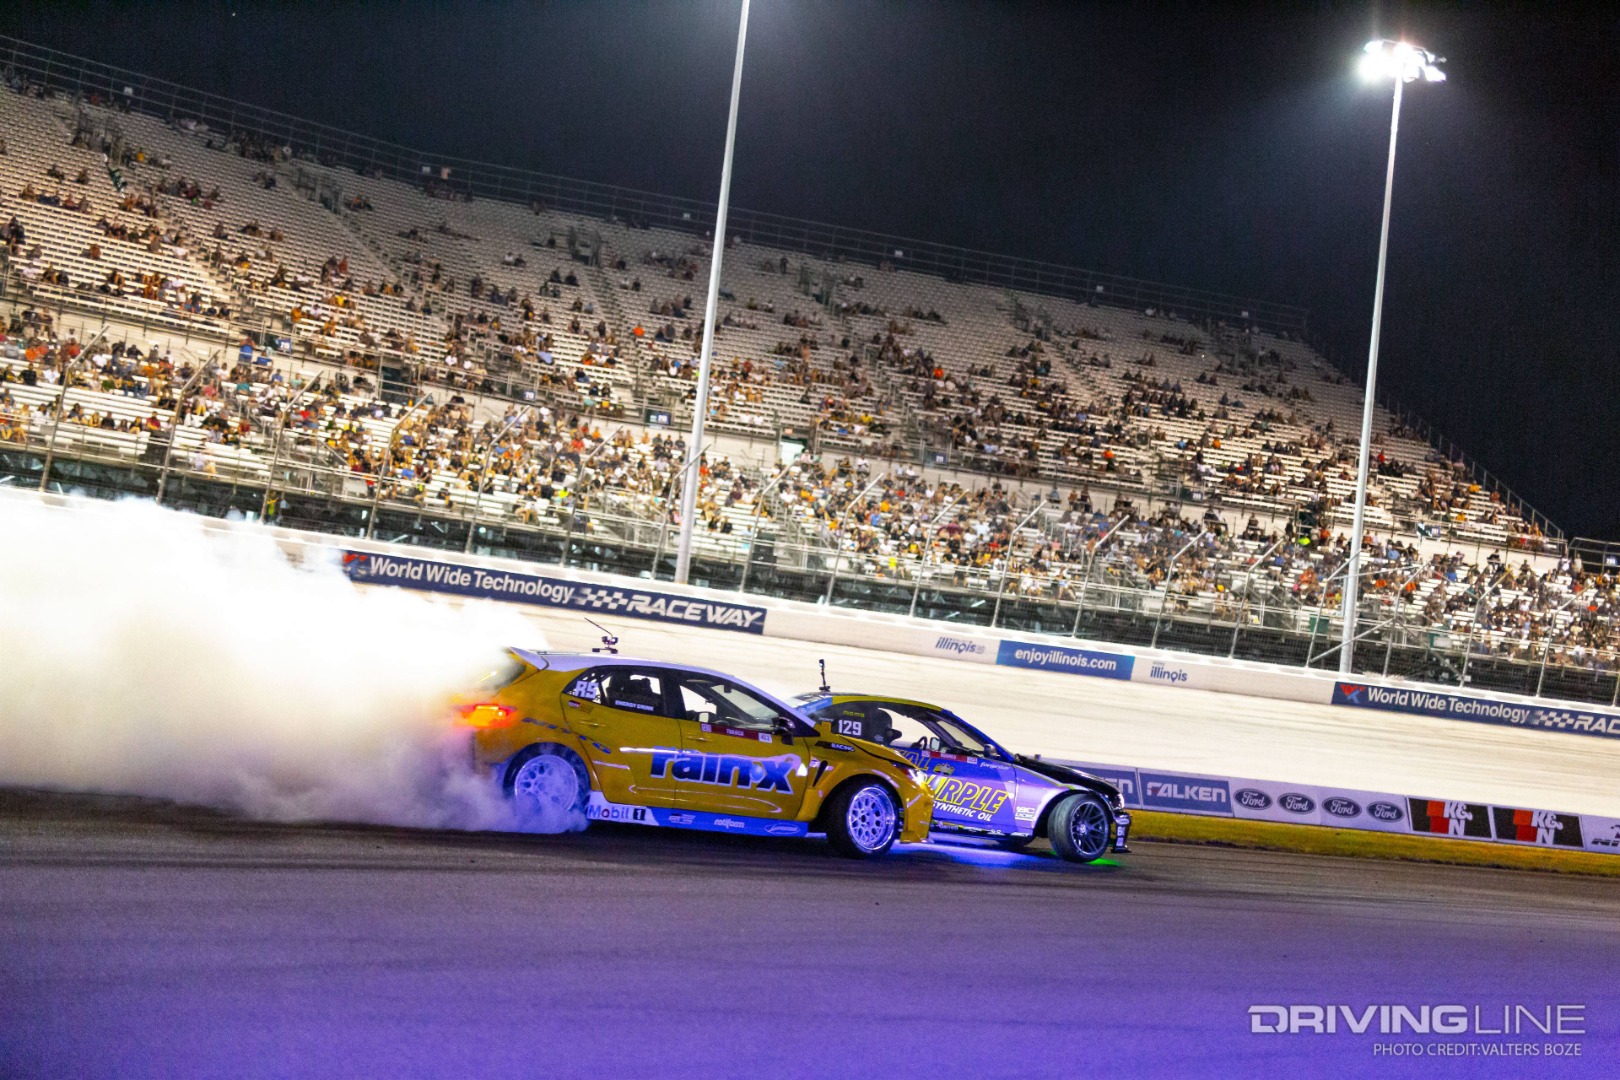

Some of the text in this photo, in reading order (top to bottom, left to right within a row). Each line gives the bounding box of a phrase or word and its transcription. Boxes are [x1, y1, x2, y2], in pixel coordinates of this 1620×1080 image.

[370, 556, 576, 604] World Wide Technology
[626, 594, 764, 628] RACEWAY
[935, 636, 977, 654] illinois
[1014, 647, 1117, 671] enjoyillinois.com
[1150, 665, 1188, 682] illinois
[1367, 687, 1530, 724] World Wide Technology
[838, 719, 862, 736] 129
[1146, 781, 1227, 803] FALKEN
[1241, 791, 1266, 807] Ford
[932, 801, 993, 822] SYNTHETIC OIL
[1285, 795, 1309, 811] Ford
[1329, 799, 1355, 816] Ford
[1373, 803, 1398, 819] Ford
[587, 804, 630, 820] Mobil
